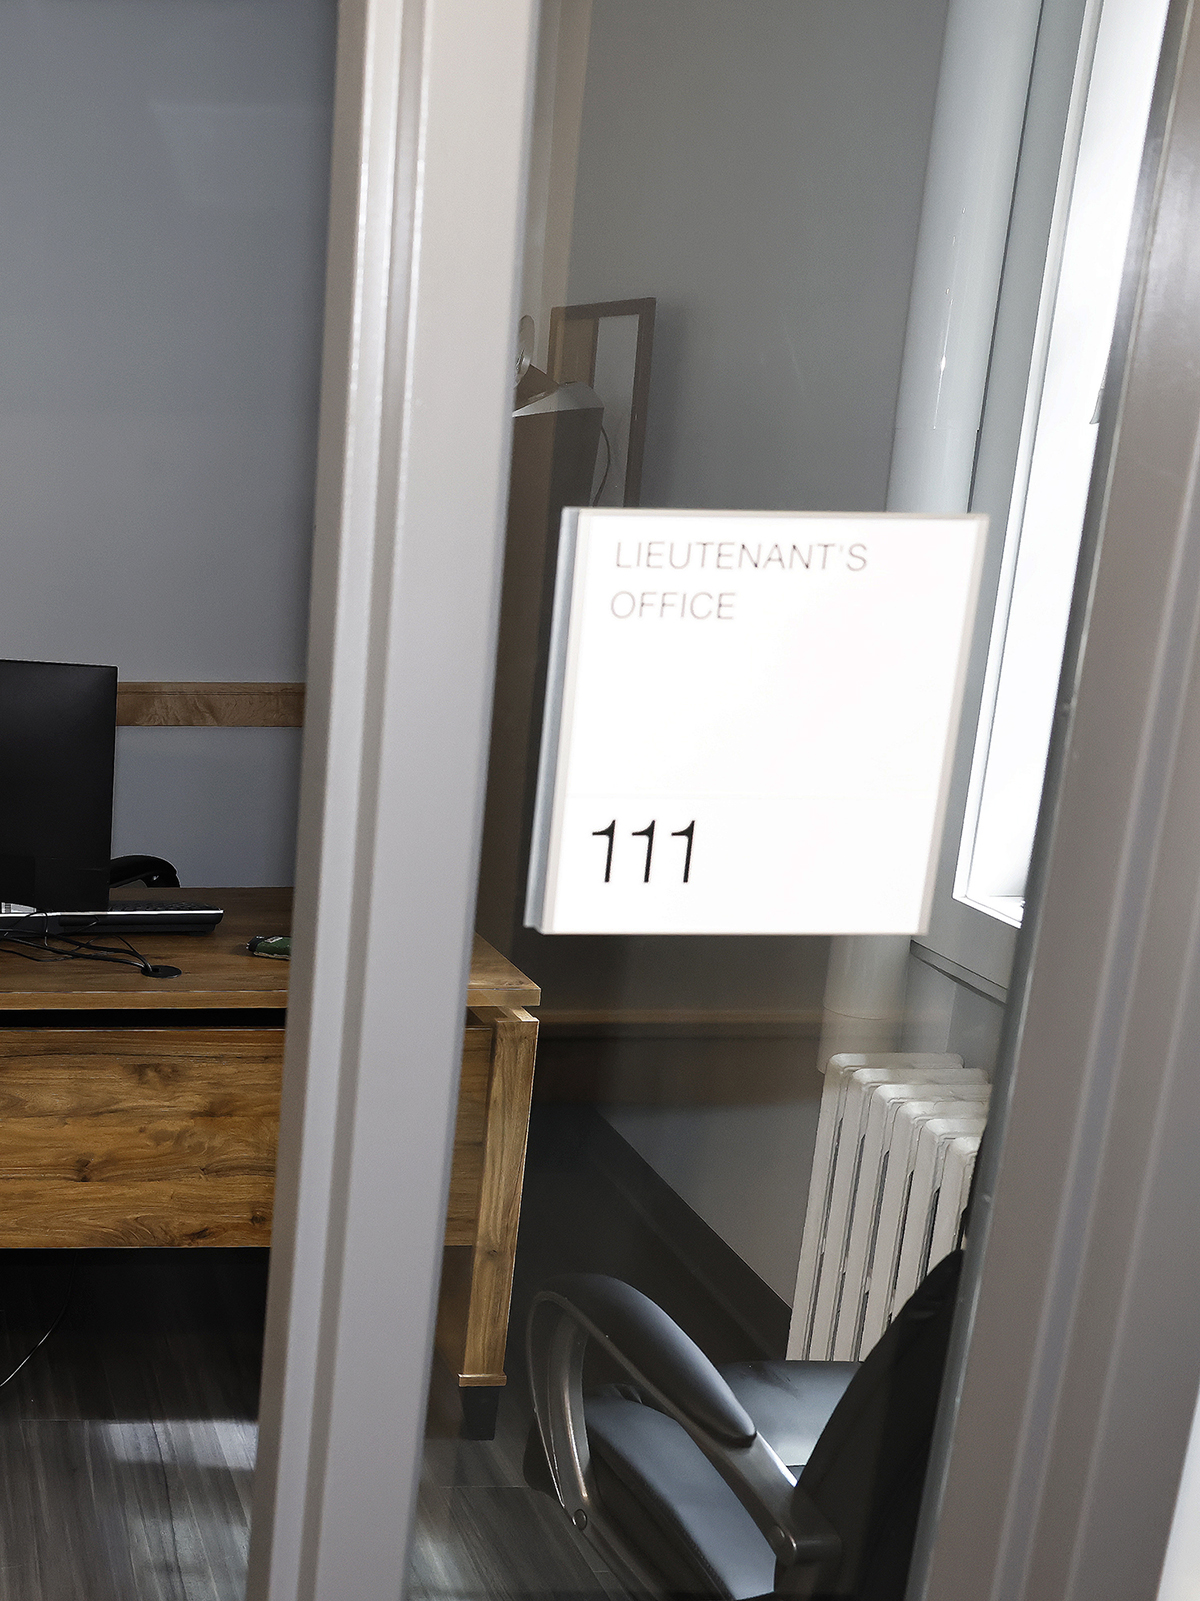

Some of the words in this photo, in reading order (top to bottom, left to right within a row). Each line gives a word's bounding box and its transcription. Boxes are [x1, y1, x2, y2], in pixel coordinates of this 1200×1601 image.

[614, 540, 869, 572] LIEUTENANT'S
[610, 590, 737, 621] OFFICE
[592, 819, 696, 884] 111
